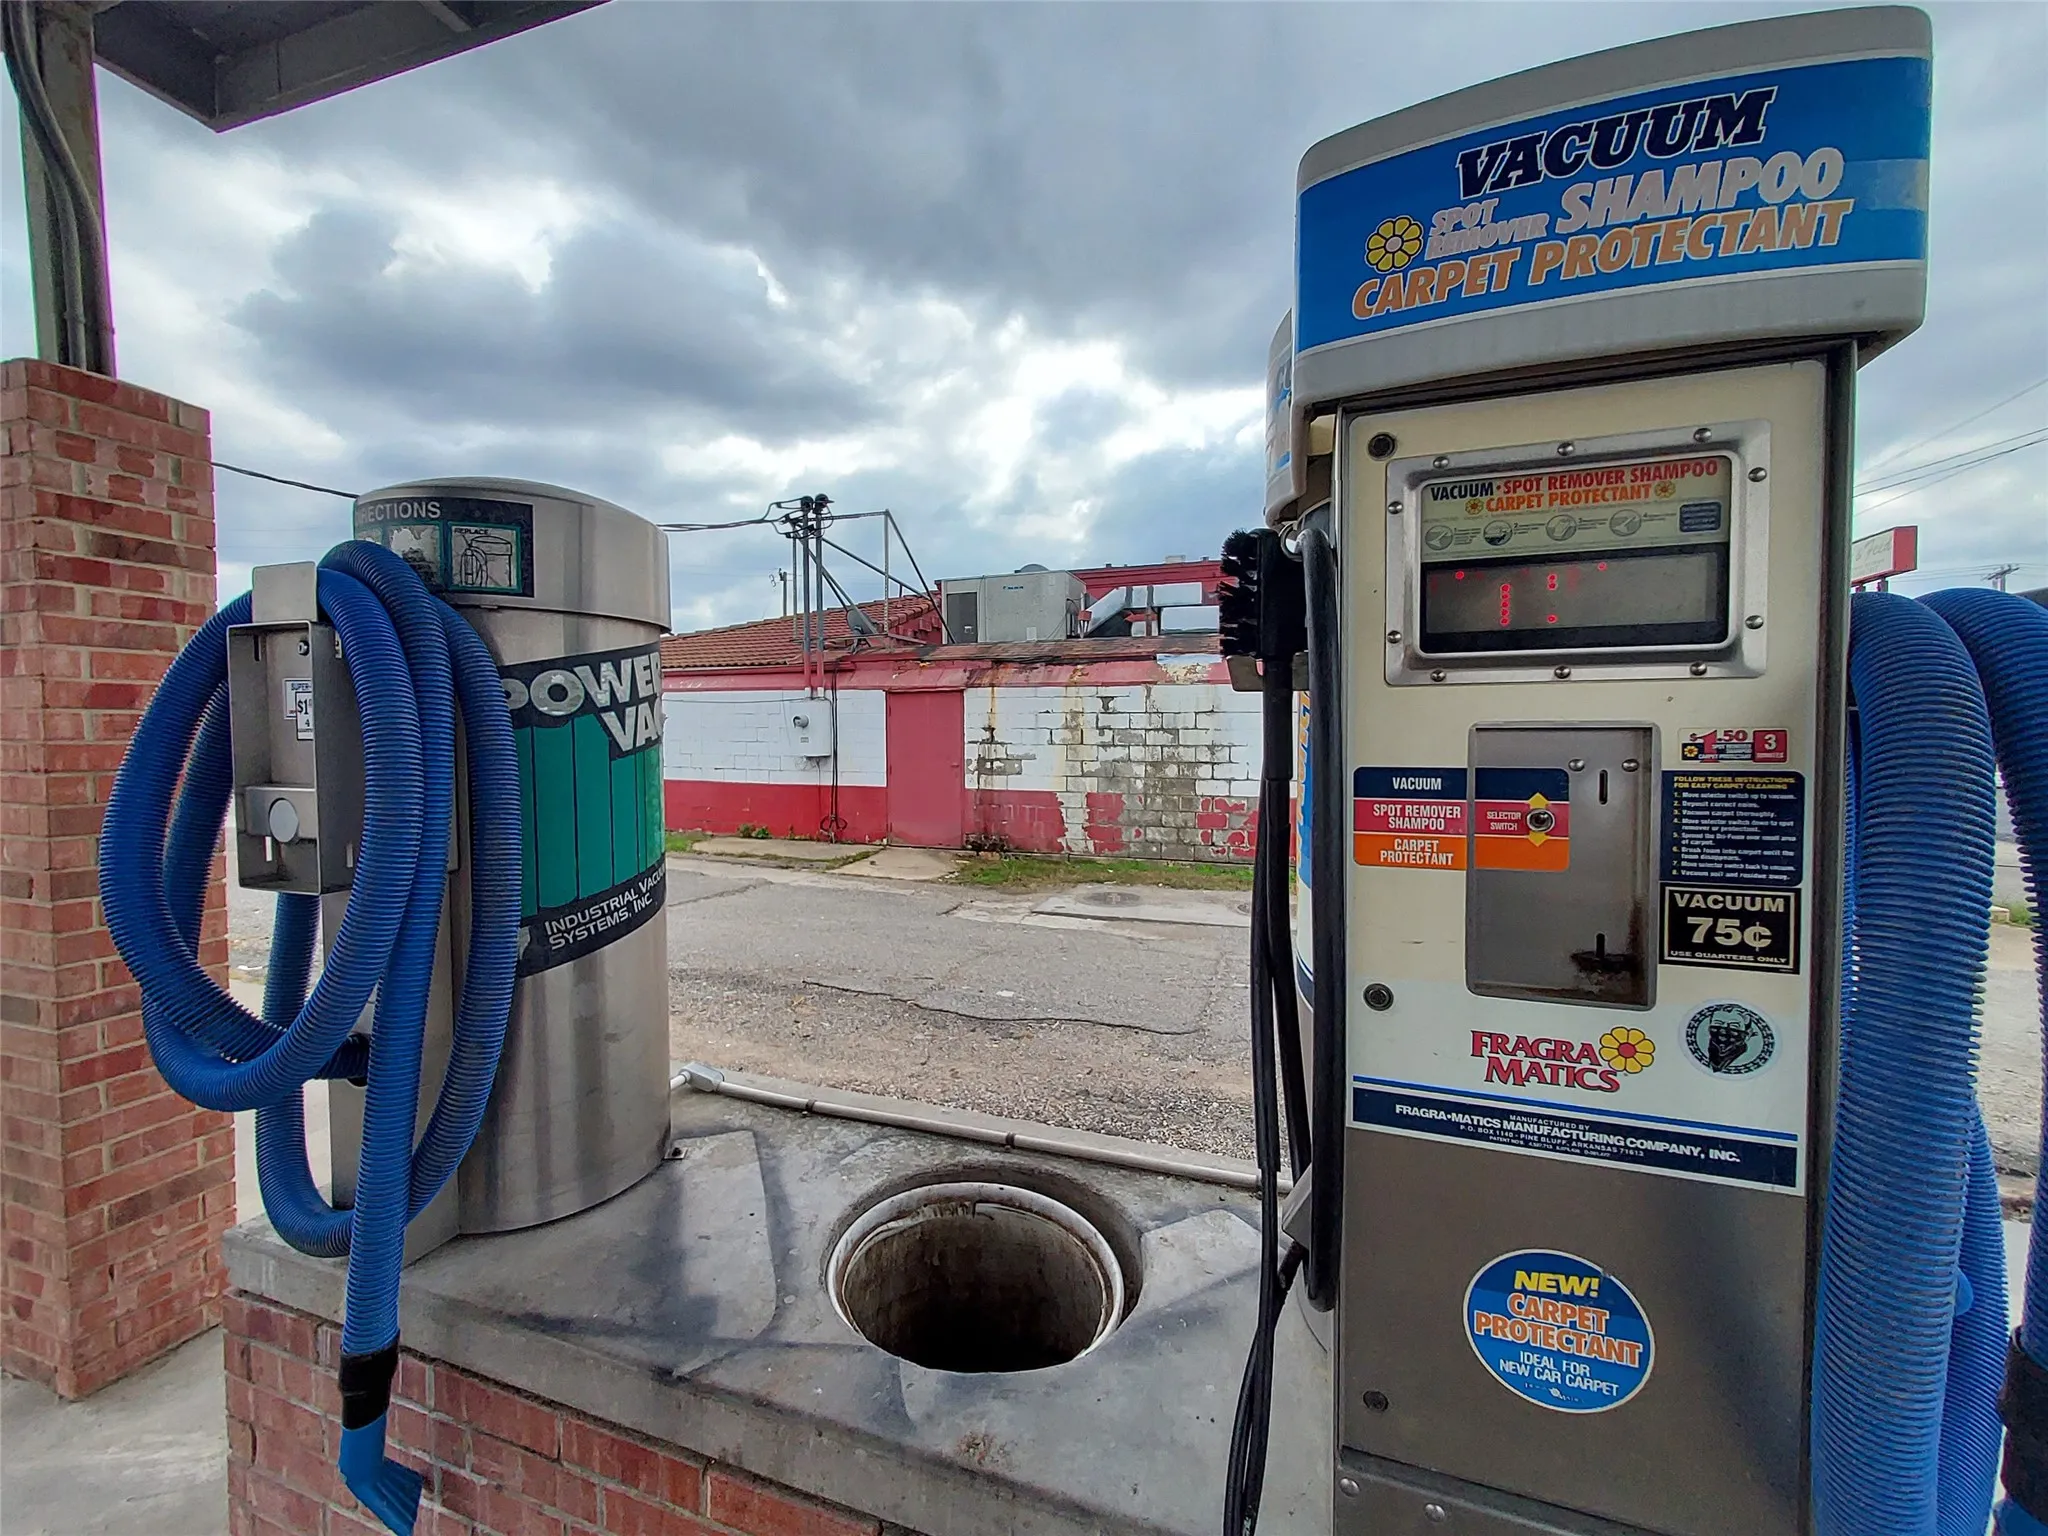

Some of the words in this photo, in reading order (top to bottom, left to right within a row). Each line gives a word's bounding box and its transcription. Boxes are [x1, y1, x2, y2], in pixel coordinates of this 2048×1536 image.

[1457, 86, 1778, 200] VACUUM
[1425, 213, 1549, 260] REMOVER
[1555, 147, 1845, 235] SHAMPOO
[1430, 199, 1499, 235] SPOT
[1352, 247, 1521, 320] CARPET
[1528, 199, 1854, 286] PROTECTANT
[1431, 482, 1493, 500] VACUUM
[1503, 477, 1544, 494] SPOT
[1548, 470, 1625, 491] REMOVER
[1630, 460, 1717, 482] SHAMPOO
[1486, 494, 1544, 512] CARPET
[1548, 484, 1652, 506] PROTECTANT
[1689, 730, 1748, 763] $1.50
[1764, 734, 1777, 750] 3
[1392, 777, 1442, 790] VACUUM
[1373, 804, 1402, 816] SPOT
[1405, 806, 1461, 819] REMOVER
[1388, 817, 1445, 831] SHAMPOO
[1486, 811, 1522, 820] SELECTOR
[1490, 822, 1518, 831] SWITCH
[1380, 850, 1454, 866] PROTECTANT
[1394, 839, 1439, 853] CARPET
[545, 887, 639, 936] INDUSTRIAL
[1673, 892, 1784, 912] VACUUM
[549, 906, 632, 950] SYSTEMS,
[1687, 916, 1772, 952] 75¢
[1694, 952, 1754, 962] QUARTERS
[1757, 956, 1787, 964] ONLY
[1471, 1030, 1601, 1066] FRAGRA
[1484, 1056, 1621, 1093] MATICS
[1510, 1114, 1577, 1129] MANUFACTURED
[1478, 1127, 1494, 1136] BOX
[1520, 1133, 1538, 1142] PINE
[1571, 1141, 1618, 1153] ARKANSAS
[1502, 1120, 1625, 1146] MANUFACTURING
[1626, 1137, 1705, 1159] COMPANY,
[1709, 1148, 1741, 1163] INC.
[1514, 1270, 1600, 1298] NEW!
[1507, 1293, 1609, 1334] CARPET
[1474, 1310, 1643, 1368] PROTECTANT
[1500, 1359, 1531, 1378] NEW
[1534, 1367, 1562, 1385] CAR
[1566, 1374, 1620, 1397] CARPET
[1520, 1350, 1556, 1370] IDEAL
[1563, 1360, 1591, 1377] FOR
